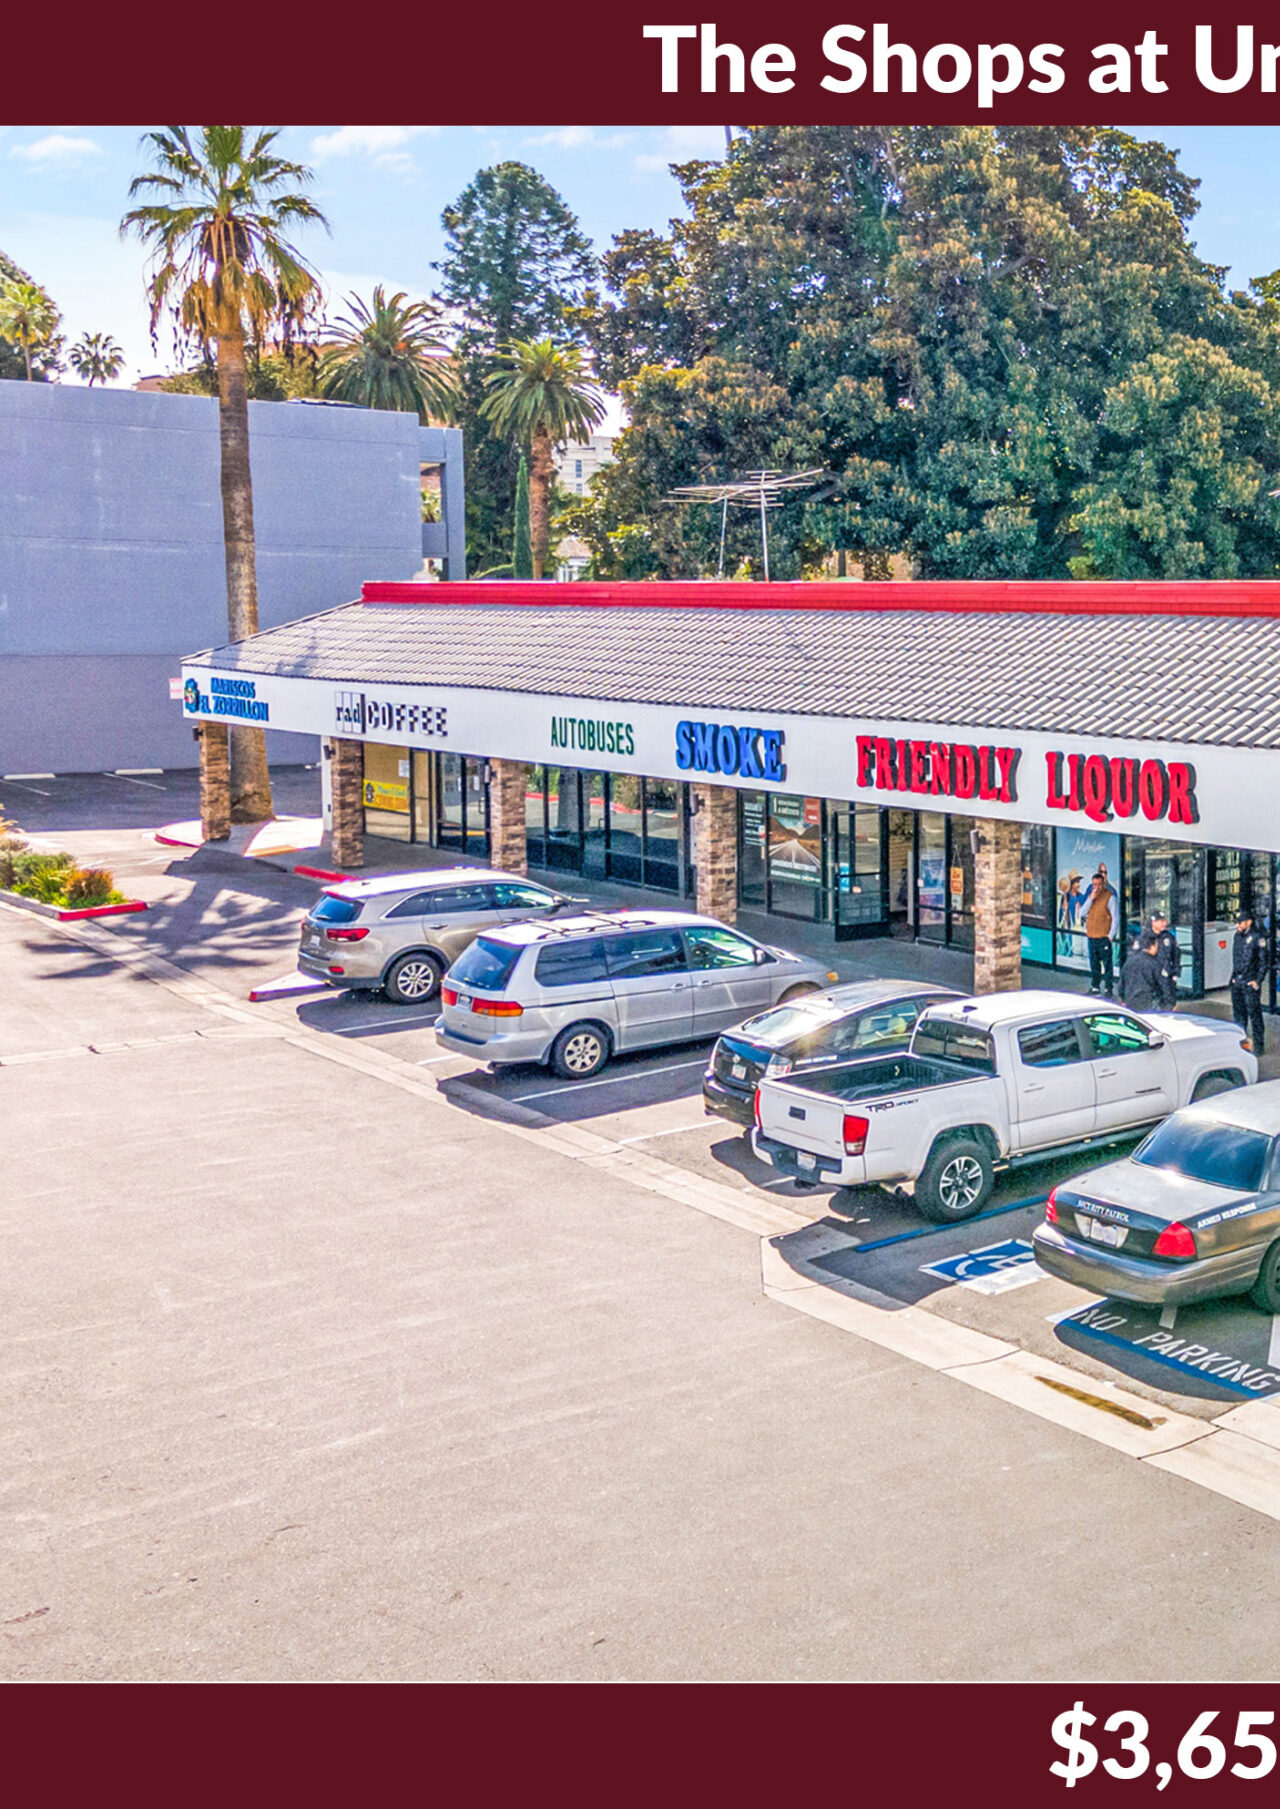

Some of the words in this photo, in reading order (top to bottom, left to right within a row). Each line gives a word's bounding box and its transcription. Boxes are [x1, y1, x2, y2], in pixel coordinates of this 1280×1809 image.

[211, 677, 255, 699] MARISCOS
[200, 695, 211, 714] EL
[212, 695, 269, 722] ZORRILLON
[336, 702, 361, 724] rad
[365, 700, 448, 737] COFFEE
[551, 716, 634, 755] AUTOBUSES
[676, 720, 786, 782] SMOKE
[856, 735, 1022, 803] FRIENDLY
[1046, 751, 1200, 824] LIQUOR
[865, 1101, 894, 1112] TRD
[1070, 1308, 1128, 1331] NO
